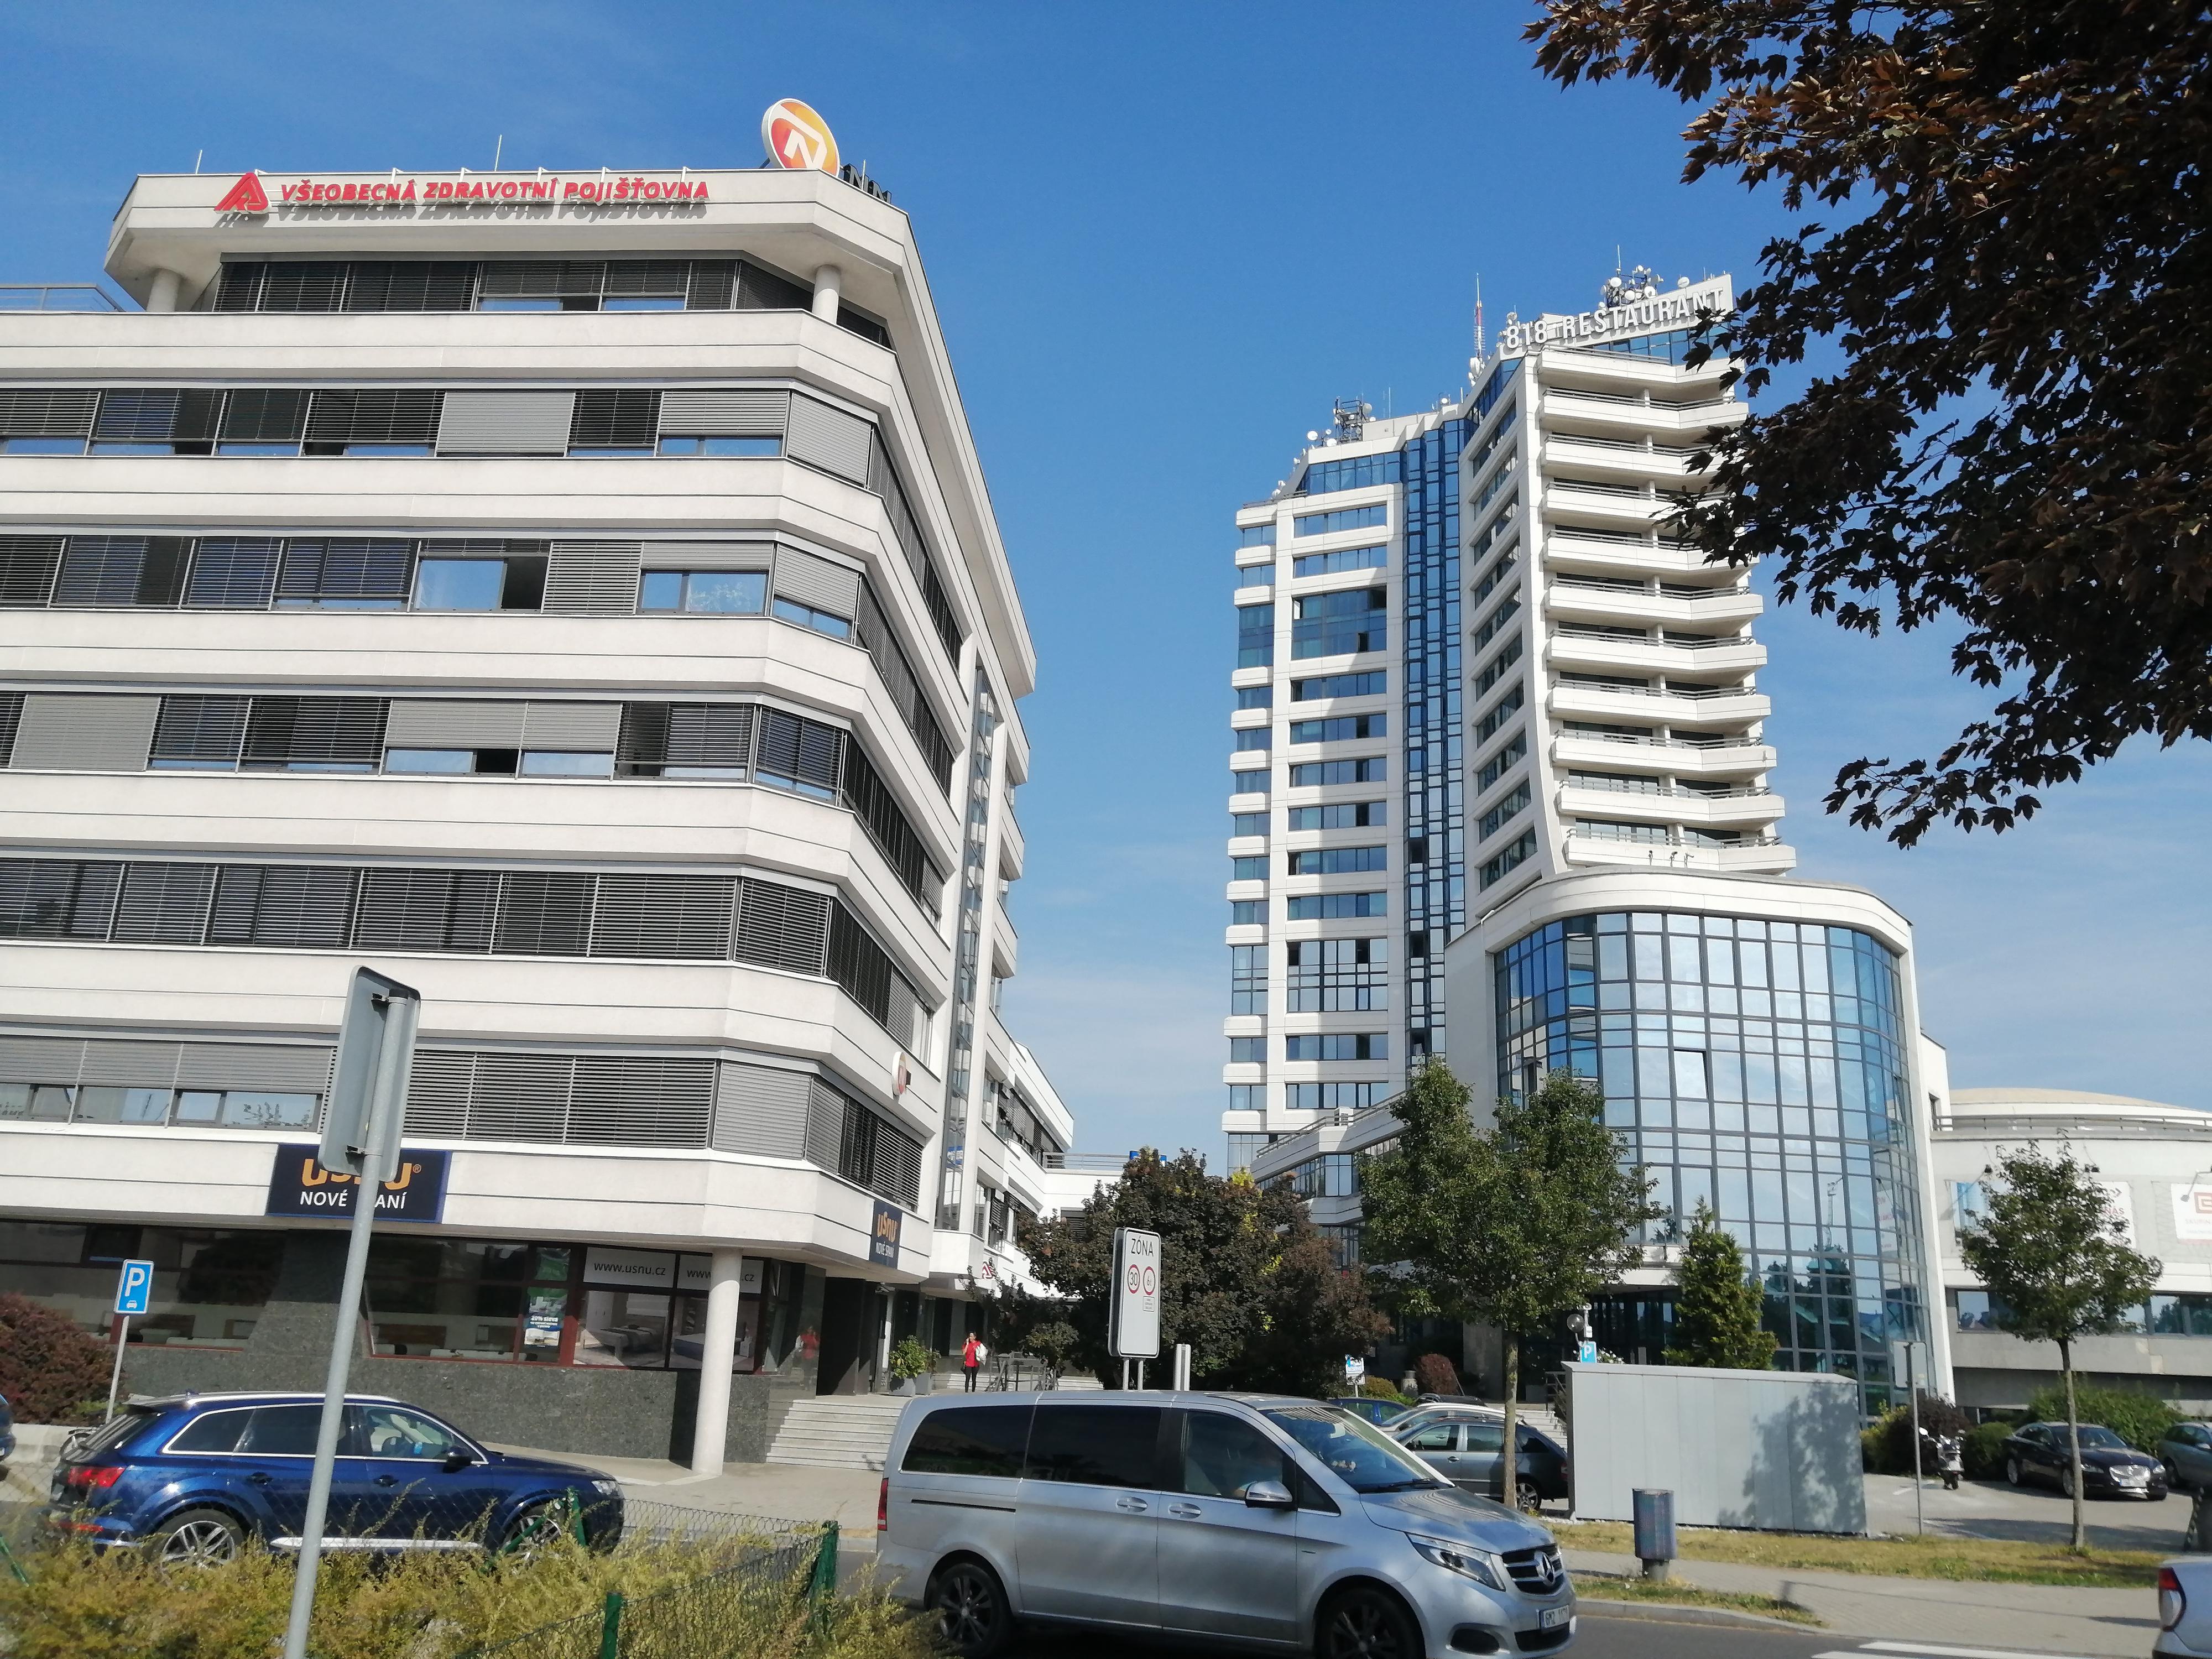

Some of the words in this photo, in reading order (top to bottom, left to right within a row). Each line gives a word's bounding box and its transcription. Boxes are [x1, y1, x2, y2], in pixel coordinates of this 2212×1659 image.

[280, 179, 416, 201] VŠEOBECNÁ
[423, 177, 558, 199] ZDRAVOTNÍ
[563, 177, 708, 202] POJIŠŤOVNA
[1506, 319, 1548, 349] 818
[1562, 287, 1724, 339] RESTAURANT
[300, 1190, 348, 1207] NOVÉ
[374, 1192, 408, 1209] ANÍ
[1131, 1235, 1154, 1257] ZÓNA
[593, 1262, 666, 1276] www.usnu.cz
[1130, 1272, 1138, 1286] 30
[124, 1267, 145, 1297] P
[1584, 1345, 1592, 1359] P
